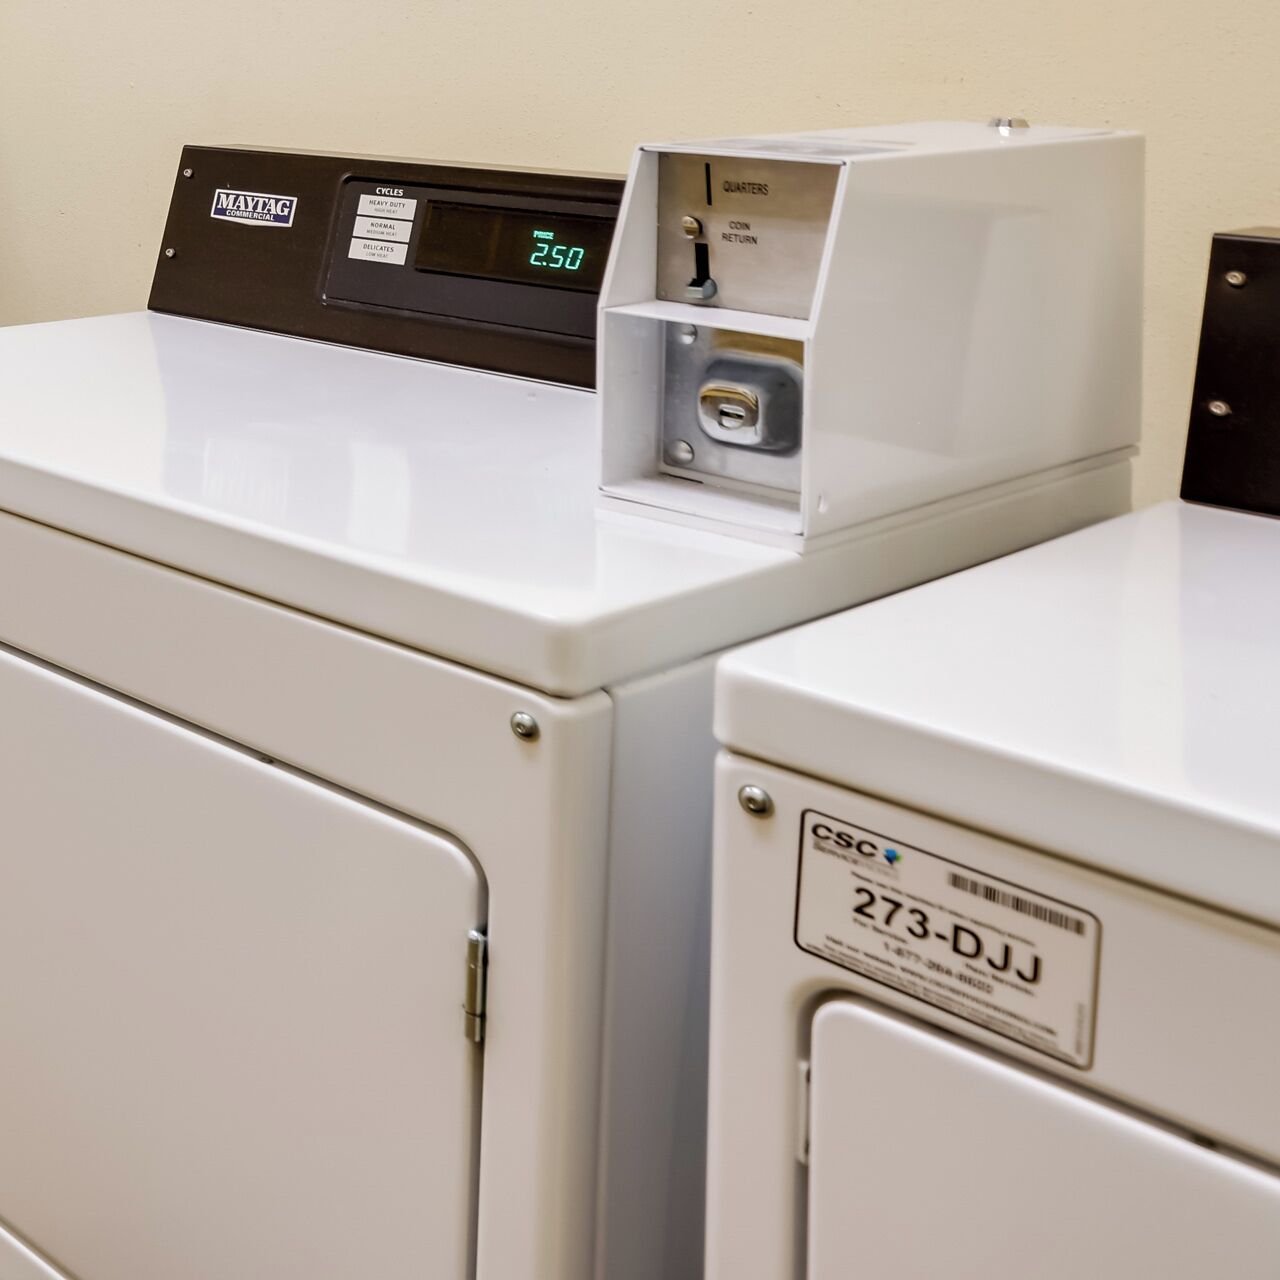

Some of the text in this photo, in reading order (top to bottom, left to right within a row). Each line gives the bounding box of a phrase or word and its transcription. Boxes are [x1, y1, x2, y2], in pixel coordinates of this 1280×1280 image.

[376, 187, 404, 196] CYCLES
[723, 180, 768, 195] QUARTERS
[217, 193, 290, 216] MAYTAG
[226, 210, 274, 221] COMMERCIAL
[370, 222, 395, 230] NORMAL
[729, 221, 750, 230] COIN
[722, 232, 757, 244] RETURN
[363, 244, 394, 252] DELICATES
[530, 243, 584, 270] 2.50
[811, 823, 878, 858] CSC
[853, 887, 1041, 984] 273-DJJ
